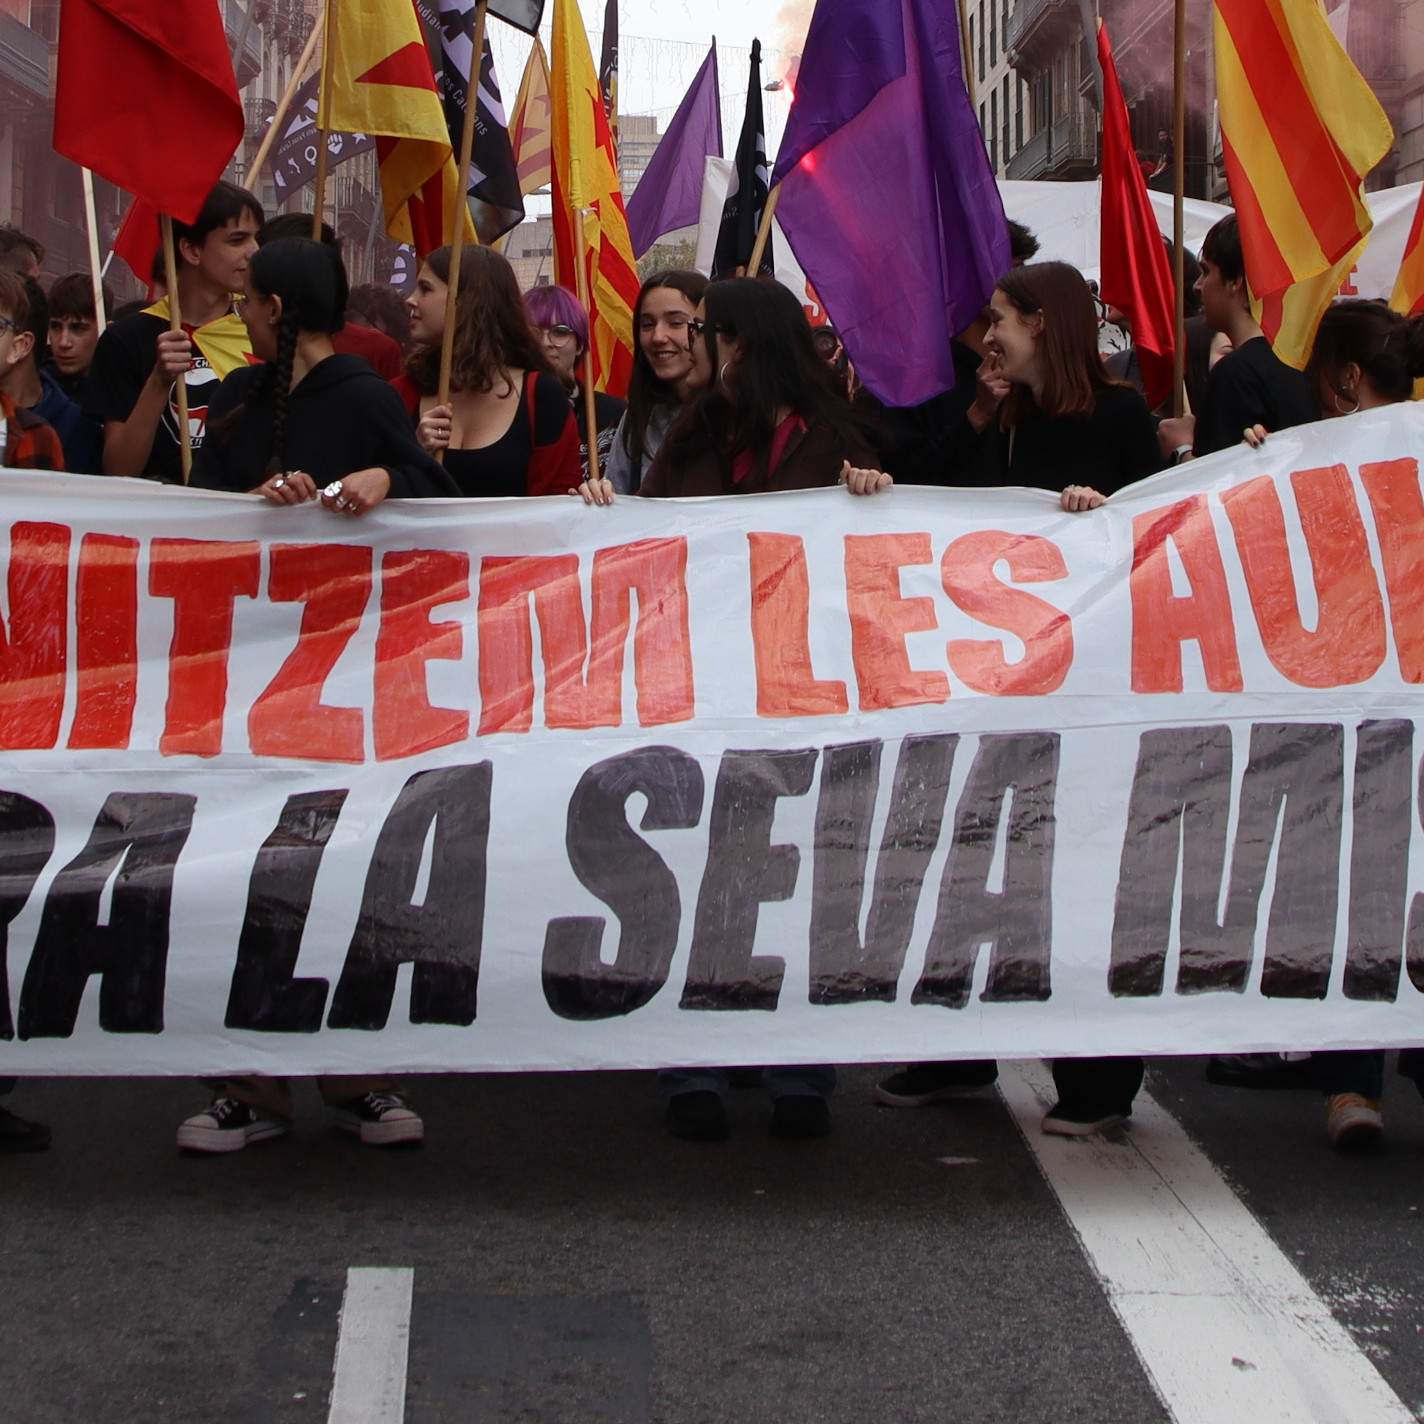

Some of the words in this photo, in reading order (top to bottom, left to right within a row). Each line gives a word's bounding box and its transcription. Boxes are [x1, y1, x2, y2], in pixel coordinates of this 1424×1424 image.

[746, 528, 1074, 718] LES
[223, 760, 494, 1033] LA
[542, 728, 1063, 1021] SEVA
